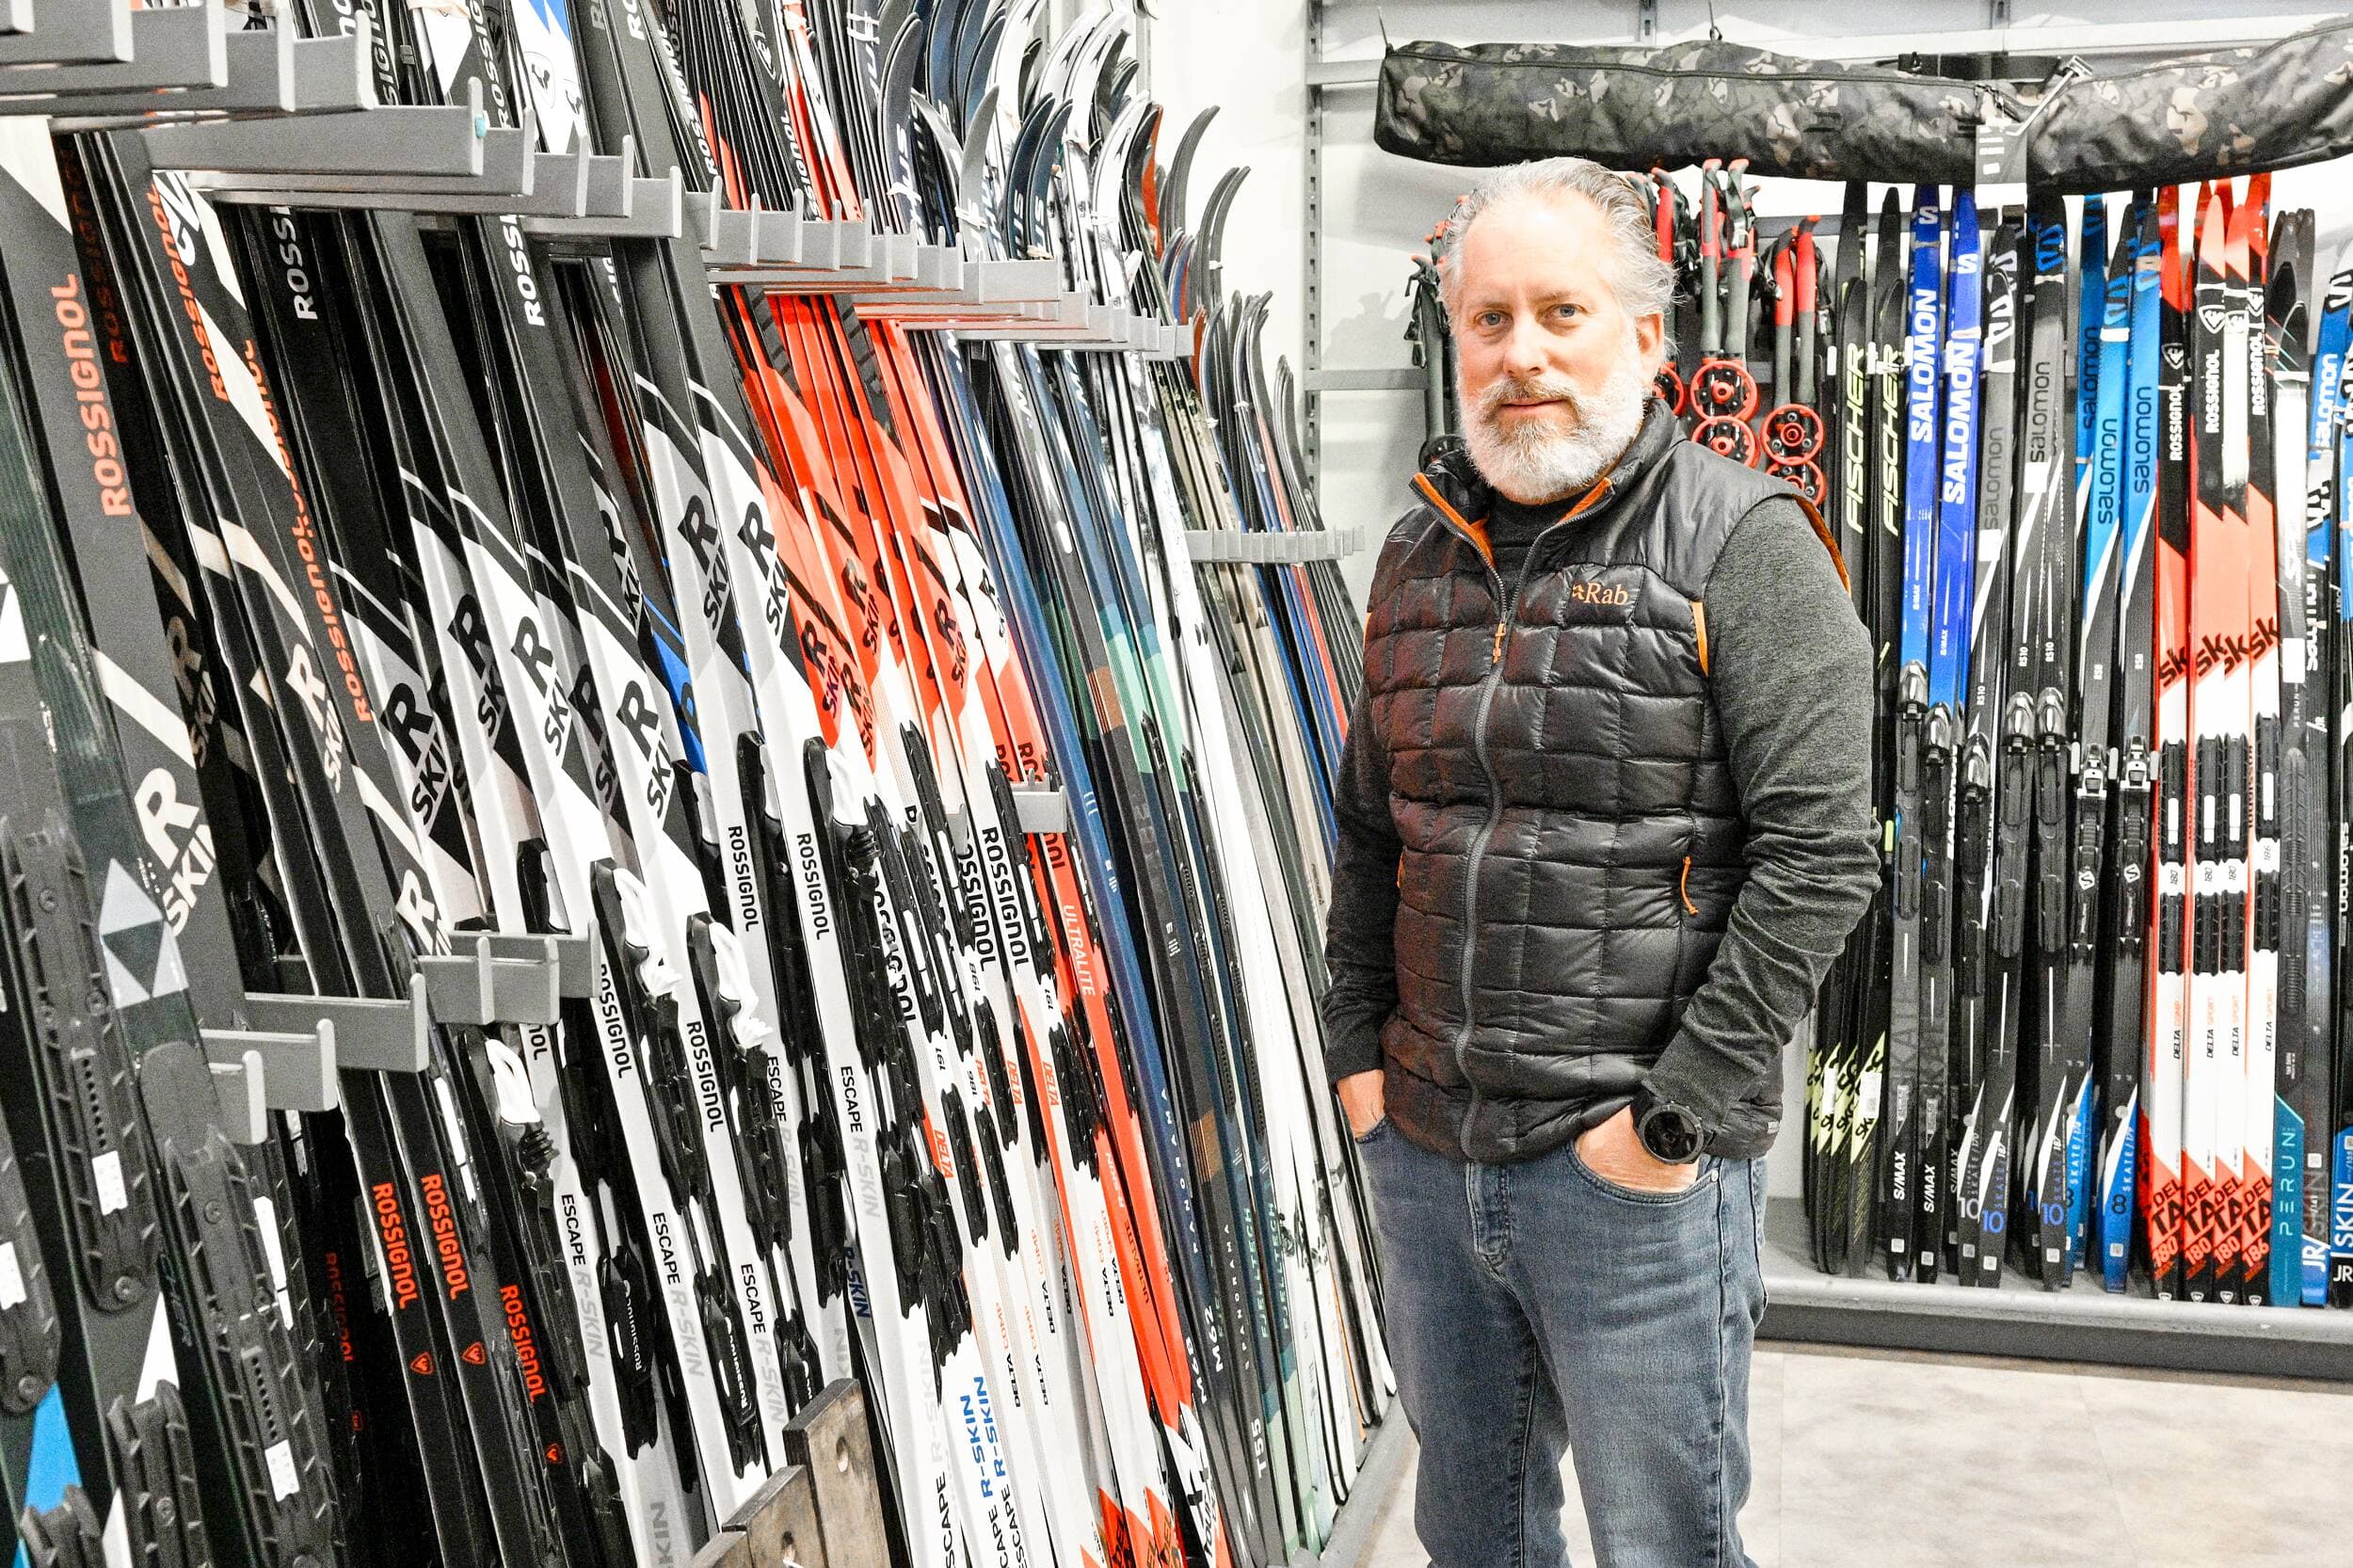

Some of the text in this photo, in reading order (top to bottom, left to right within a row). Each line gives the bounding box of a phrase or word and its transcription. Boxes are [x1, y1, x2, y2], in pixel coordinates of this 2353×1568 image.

[471, 0, 512, 129] ROSSIG
[658, 23, 719, 176] ROSSIGNOL
[146, 182, 232, 403] ROSSIGNOL
[273, 205, 318, 320] ROSSI
[499, 215, 546, 327] ROSSI
[52, 273, 132, 516] ROSSIGNOL
[1911, 288, 1937, 443] SALOMON
[2204, 348, 2220, 434] ROSSIGNOL
[2249, 331, 2265, 416] ROSSIGNOL
[1846, 343, 1865, 535] FISCHER
[1881, 344, 1899, 536] FISCHER
[1944, 340, 1976, 505] SALOMON
[2169, 383, 2184, 461] ROSSIGNOL
[678, 495, 718, 576] R
[738, 501, 776, 581] R
[291, 516, 373, 723] ROSSIGNOL
[934, 598, 957, 650] R
[1583, 582, 1629, 605] Rab
[447, 593, 492, 680] R
[511, 616, 553, 698] R
[801, 619, 828, 677] R
[2045, 641, 2055, 663] RS10
[285, 643, 326, 733] R
[380, 682, 434, 769] R
[616, 680, 660, 763] R
[1977, 685, 1986, 706] RS10
[324, 699, 343, 793] SKIN
[135, 768, 200, 869] R
[2262, 843, 2272, 861] 186
[162, 824, 216, 937] SKIN
[395, 870, 436, 954] R
[728, 824, 760, 933] ROSSIGNOL
[796, 833, 832, 940] ROSSIGNOL
[958, 829, 998, 972] OSSIGNOL
[981, 826, 1030, 973] ROSSIGNOL
[2169, 869, 2179, 886] 180
[2204, 867, 2214, 883] 180
[2228, 865, 2237, 882] 180
[1063, 905, 1096, 997] ULTRALITE
[686, 1020, 725, 1133] ROSSIGNOL
[2173, 1030, 2182, 1060] DELTA
[2206, 1029, 2215, 1059] DELTA
[2232, 1027, 2240, 1057] DELTA
[2265, 1021, 2273, 1052] DELTA
[1007, 1060, 1023, 1106] DELTA
[1042, 1060, 1060, 1107] DELTA
[840, 1065, 880, 1219] ESCAPE R-SKIN
[934, 1128, 954, 1179] DELTA
[1161, 1087, 1199, 1255] PANORAMA
[1893, 1150, 1906, 1201] S/MAX
[1924, 1165, 1936, 1213] S/MAX
[1957, 1196, 1979, 1220] 10
[1980, 1210, 2005, 1233] 10
[2041, 1203, 2065, 1225] 10
[2110, 1194, 2127, 1215] 8
[2280, 1131, 2297, 1237] PERUN
[2334, 1182, 2353, 1249] SKIN
[373, 1182, 419, 1310] ROSSIGNOL
[421, 1174, 469, 1301] ROSSIGNOL
[560, 1193, 605, 1359] ESCAPE R-SKIN
[1244, 1208, 1270, 1338] FJELLTECH
[1268, 1203, 1289, 1330] FJELLTECH
[2152, 1236, 2179, 1267] 180
[2185, 1237, 2213, 1266] 180
[2214, 1235, 2241, 1265] 180
[2242, 1237, 2270, 1268] 186
[2333, 1264, 2353, 1283] JR
[652, 1212, 705, 1378] ESCAPE R-SKIN
[843, 1245, 872, 1319] R-SKIN
[1041, 1280, 1056, 1334] DELTA
[1061, 1264, 1073, 1315] DELTA
[1101, 1267, 1114, 1317] DELTA
[1112, 1256, 1125, 1304] DELTA
[500, 1285, 549, 1403] ROSSIGNOL
[741, 1263, 786, 1425] ESCAPE R-SKIN
[1035, 1353, 1048, 1406] DELTA
[1204, 1304, 1224, 1373] M62
[1005, 1352, 1021, 1408] DELTA
[960, 1395, 994, 1499] R-SKIN
[974, 1376, 1007, 1478] R-SKIN
[1251, 1417, 1268, 1479] T55
